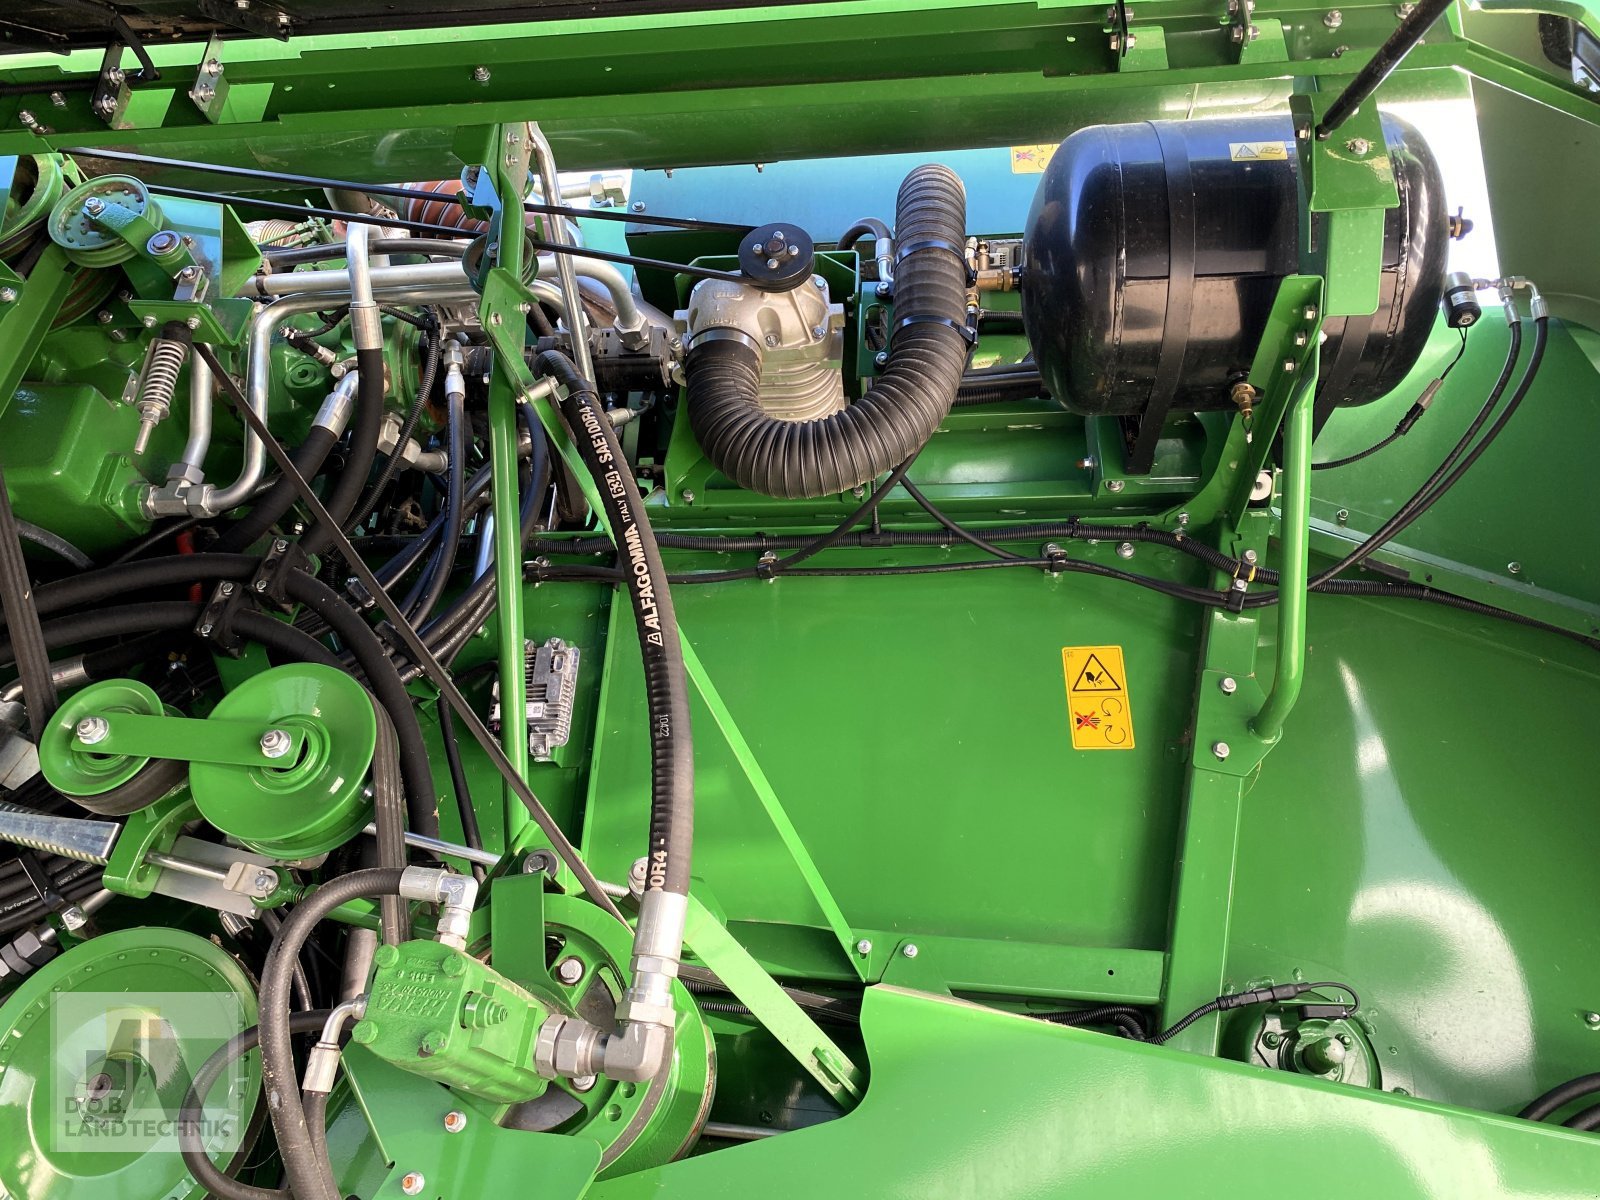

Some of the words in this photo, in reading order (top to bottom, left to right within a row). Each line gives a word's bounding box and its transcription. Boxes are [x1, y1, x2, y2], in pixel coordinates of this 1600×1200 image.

[579, 404, 613, 464] SAE100R4
[606, 471, 625, 497] 634
[617, 499, 631, 523] ITALY
[624, 522, 661, 631] ALFAGOMMA
